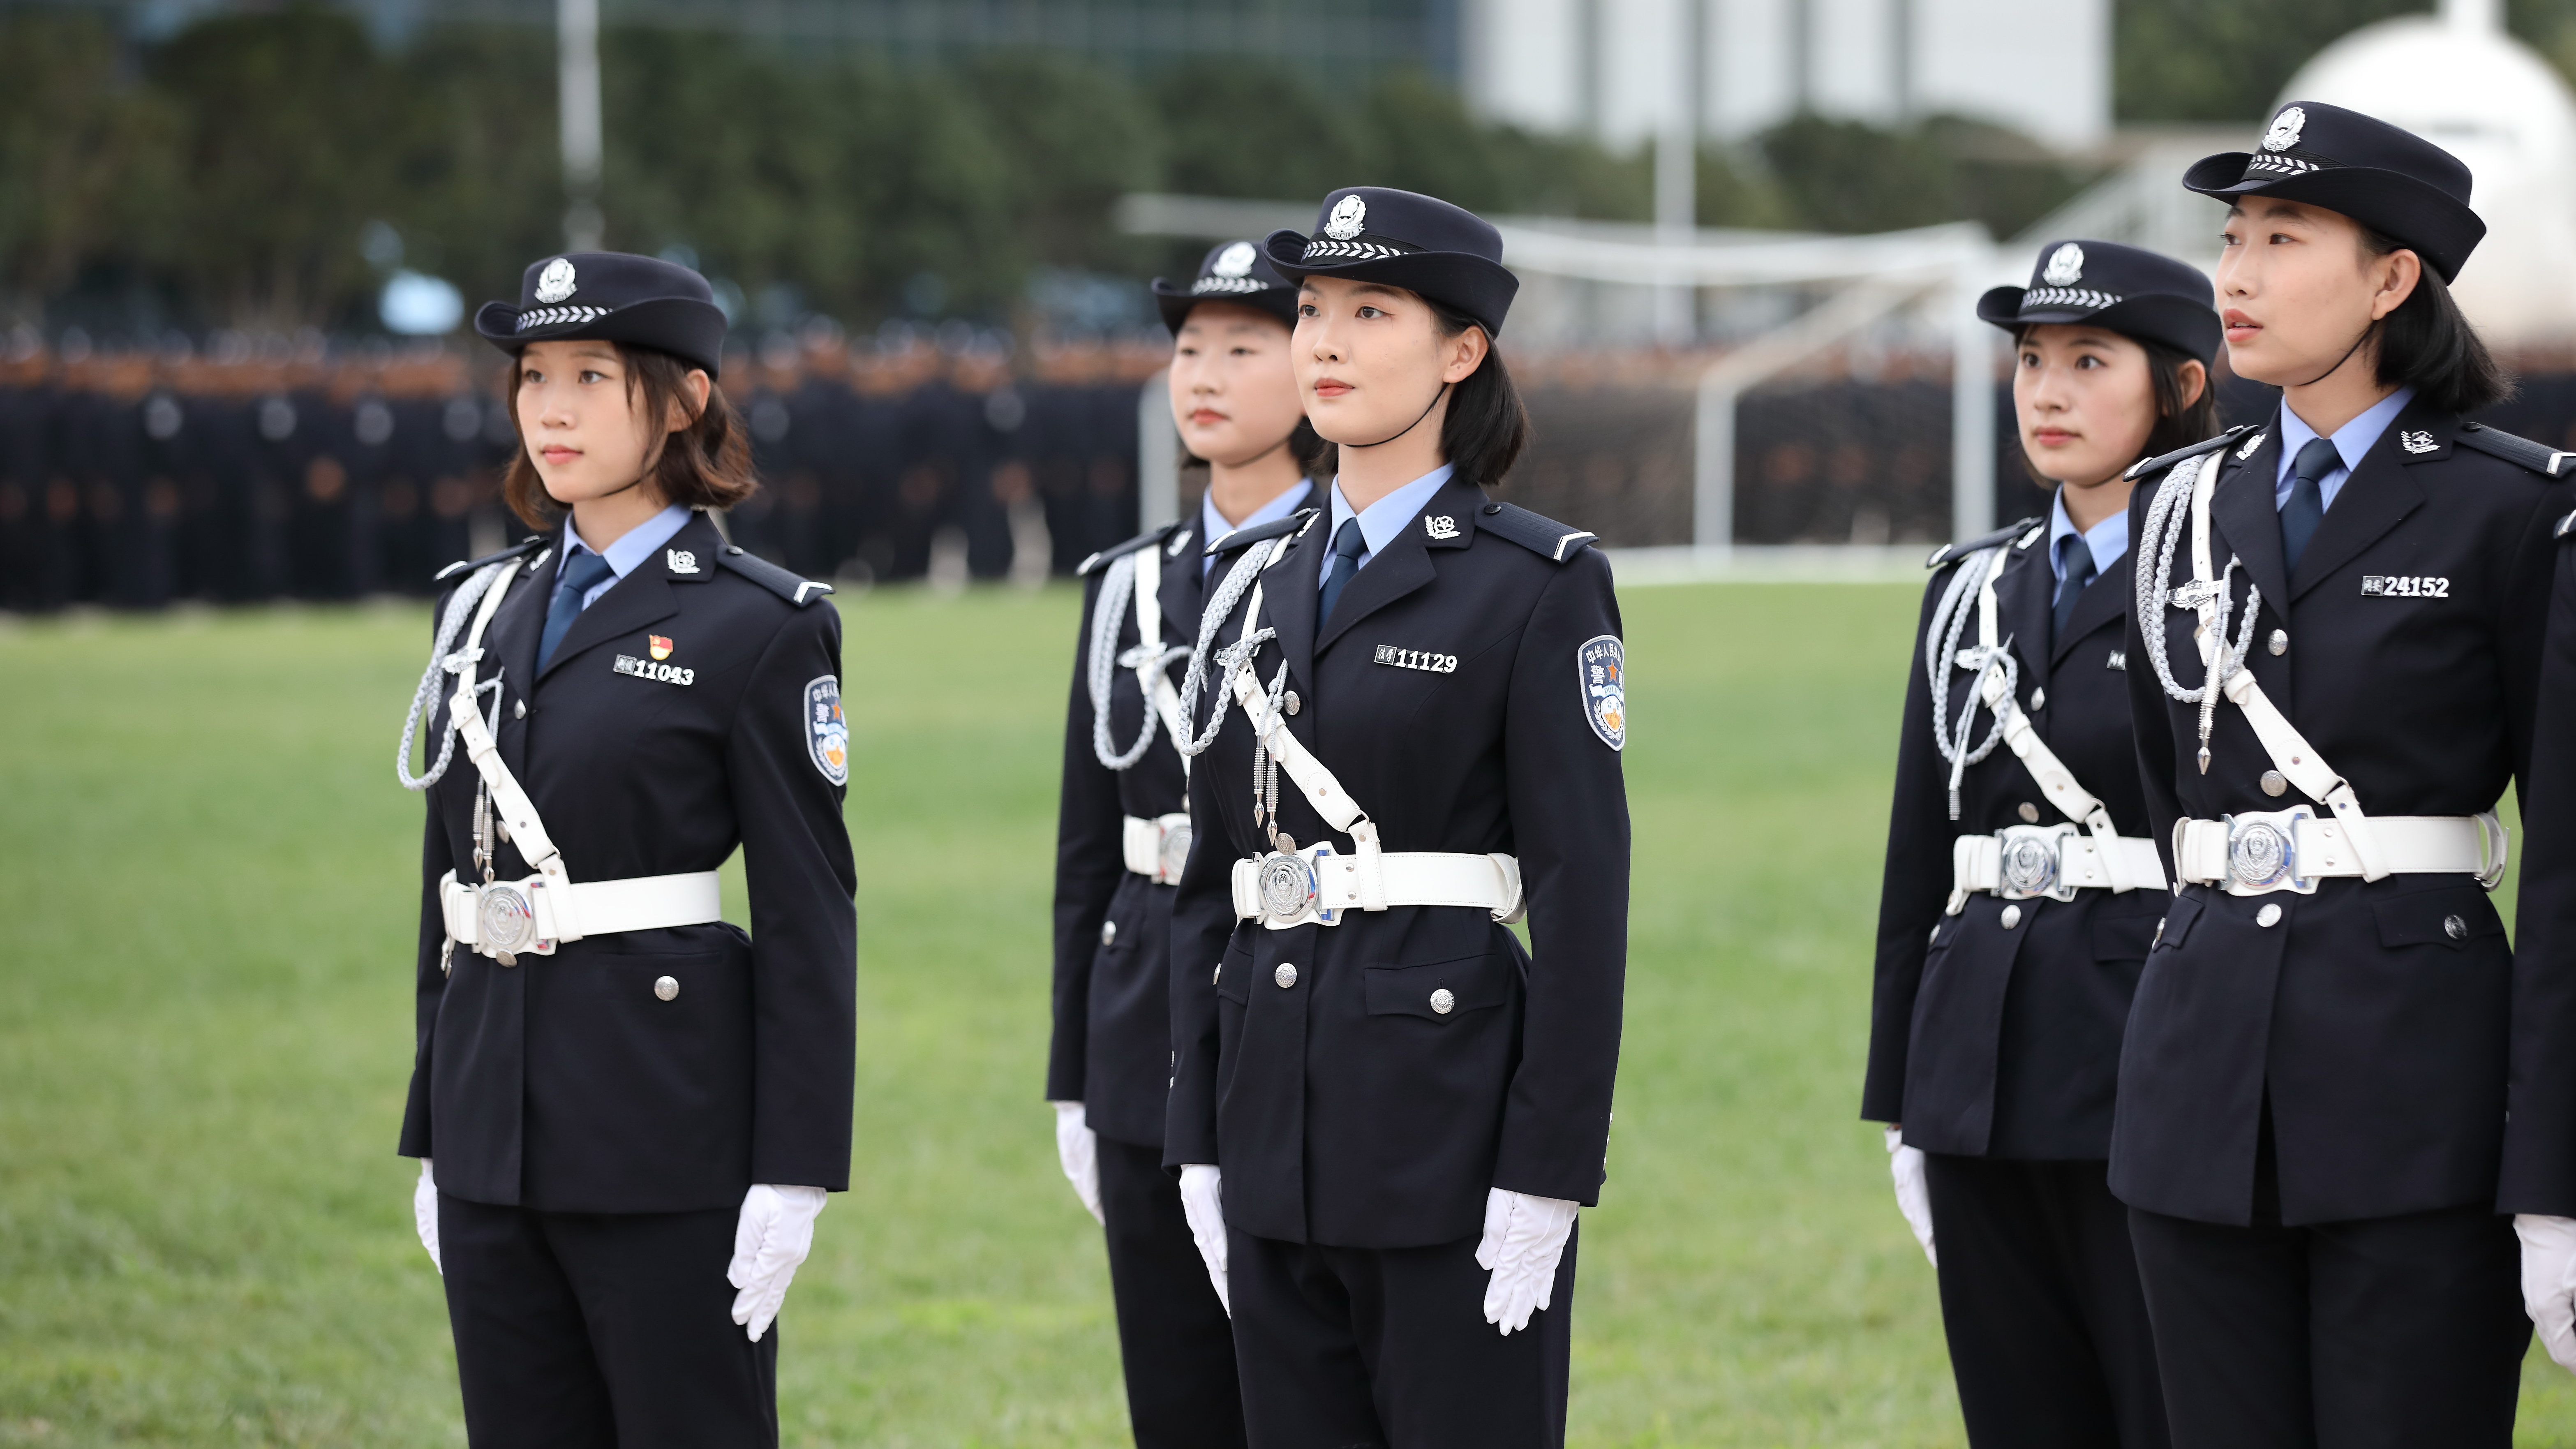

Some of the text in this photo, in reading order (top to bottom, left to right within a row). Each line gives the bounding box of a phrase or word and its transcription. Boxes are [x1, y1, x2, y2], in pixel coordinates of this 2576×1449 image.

[2383, 577, 2449, 597] 24152
[633, 660, 695, 686] 11043
[1396, 649, 1457, 673] 11129
